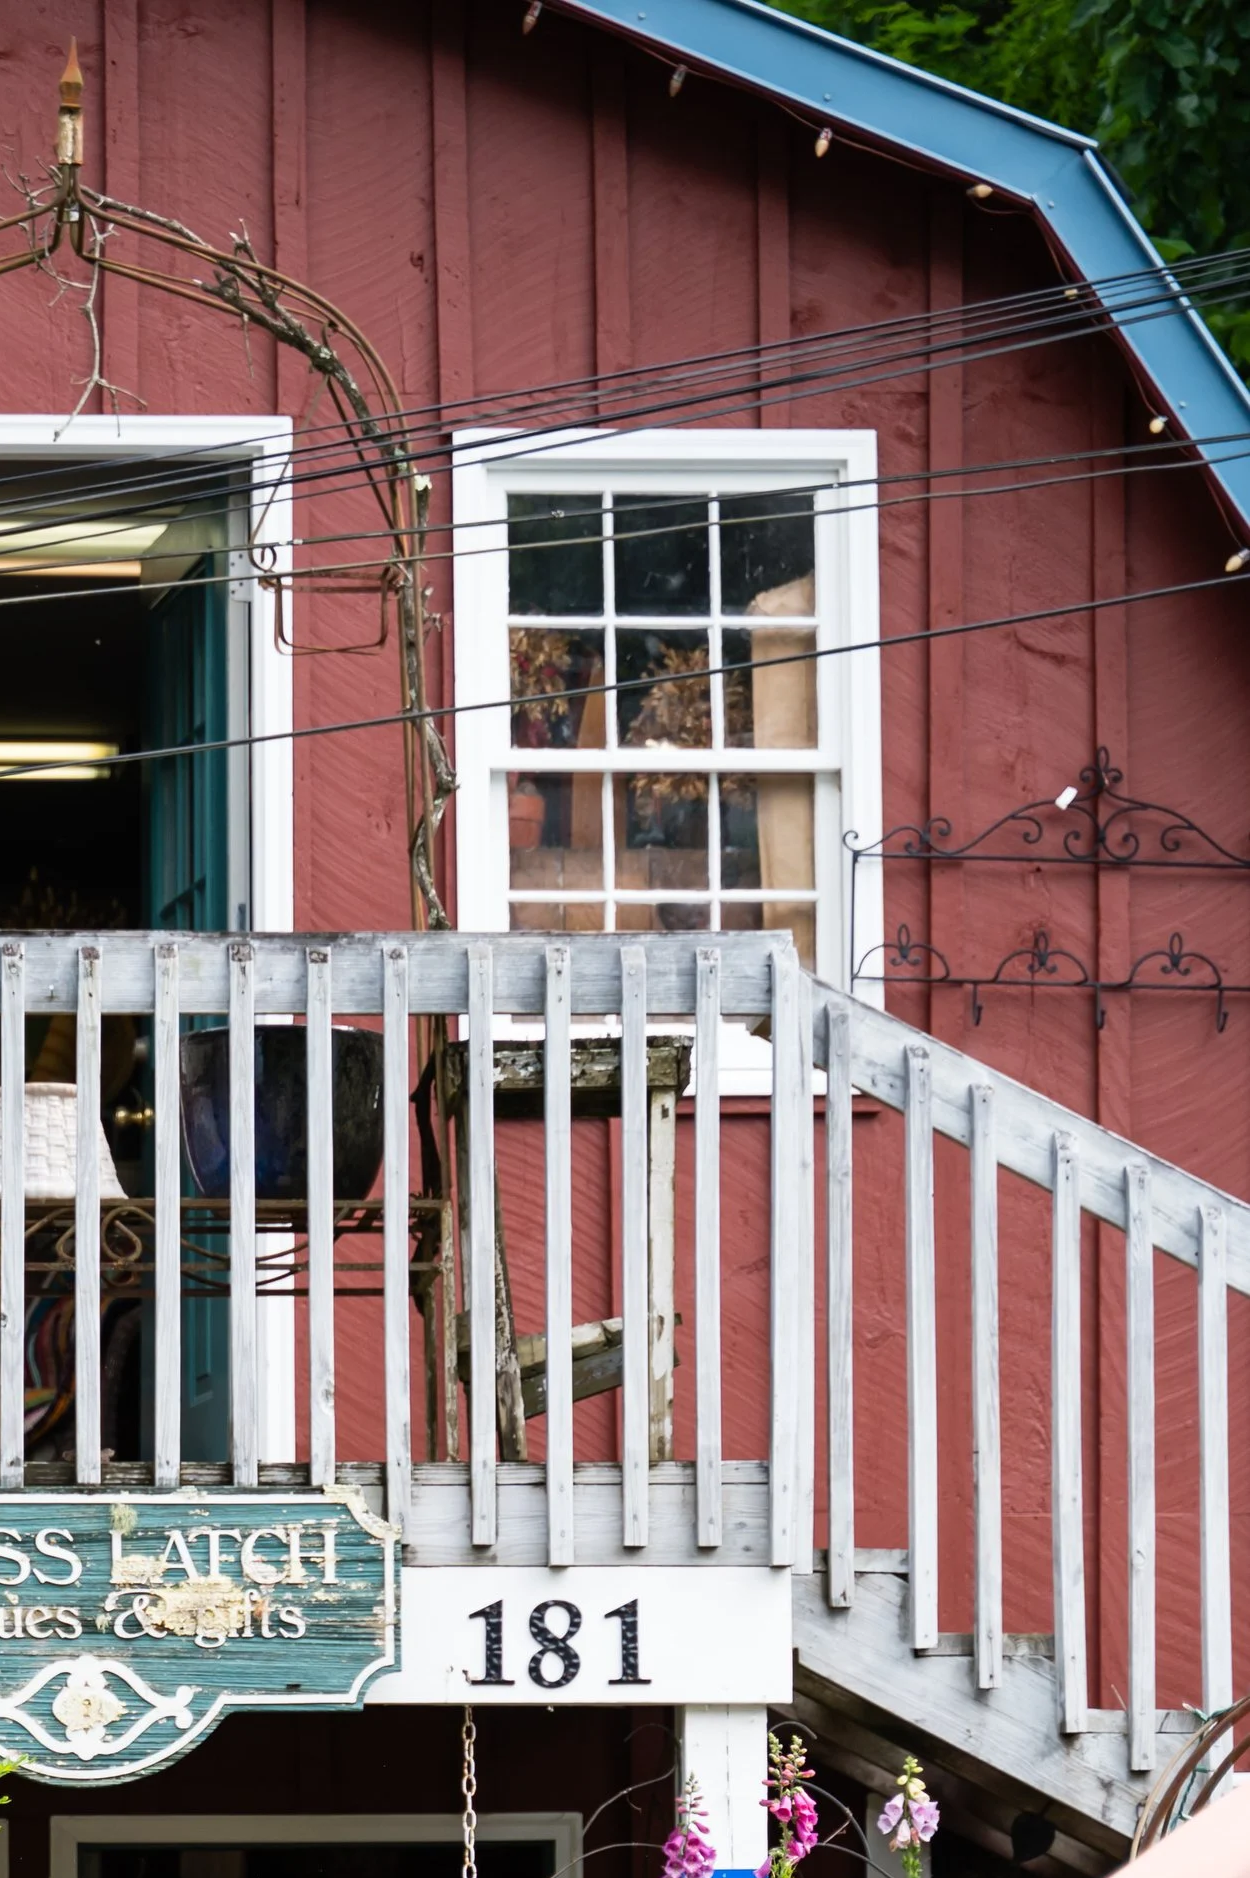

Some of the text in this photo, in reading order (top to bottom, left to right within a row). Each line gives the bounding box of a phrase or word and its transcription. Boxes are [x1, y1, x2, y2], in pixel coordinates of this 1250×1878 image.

[109, 1528, 340, 1585] LATCH
[103, 1588, 168, 1640] &
[468, 1598, 652, 1689] 181
